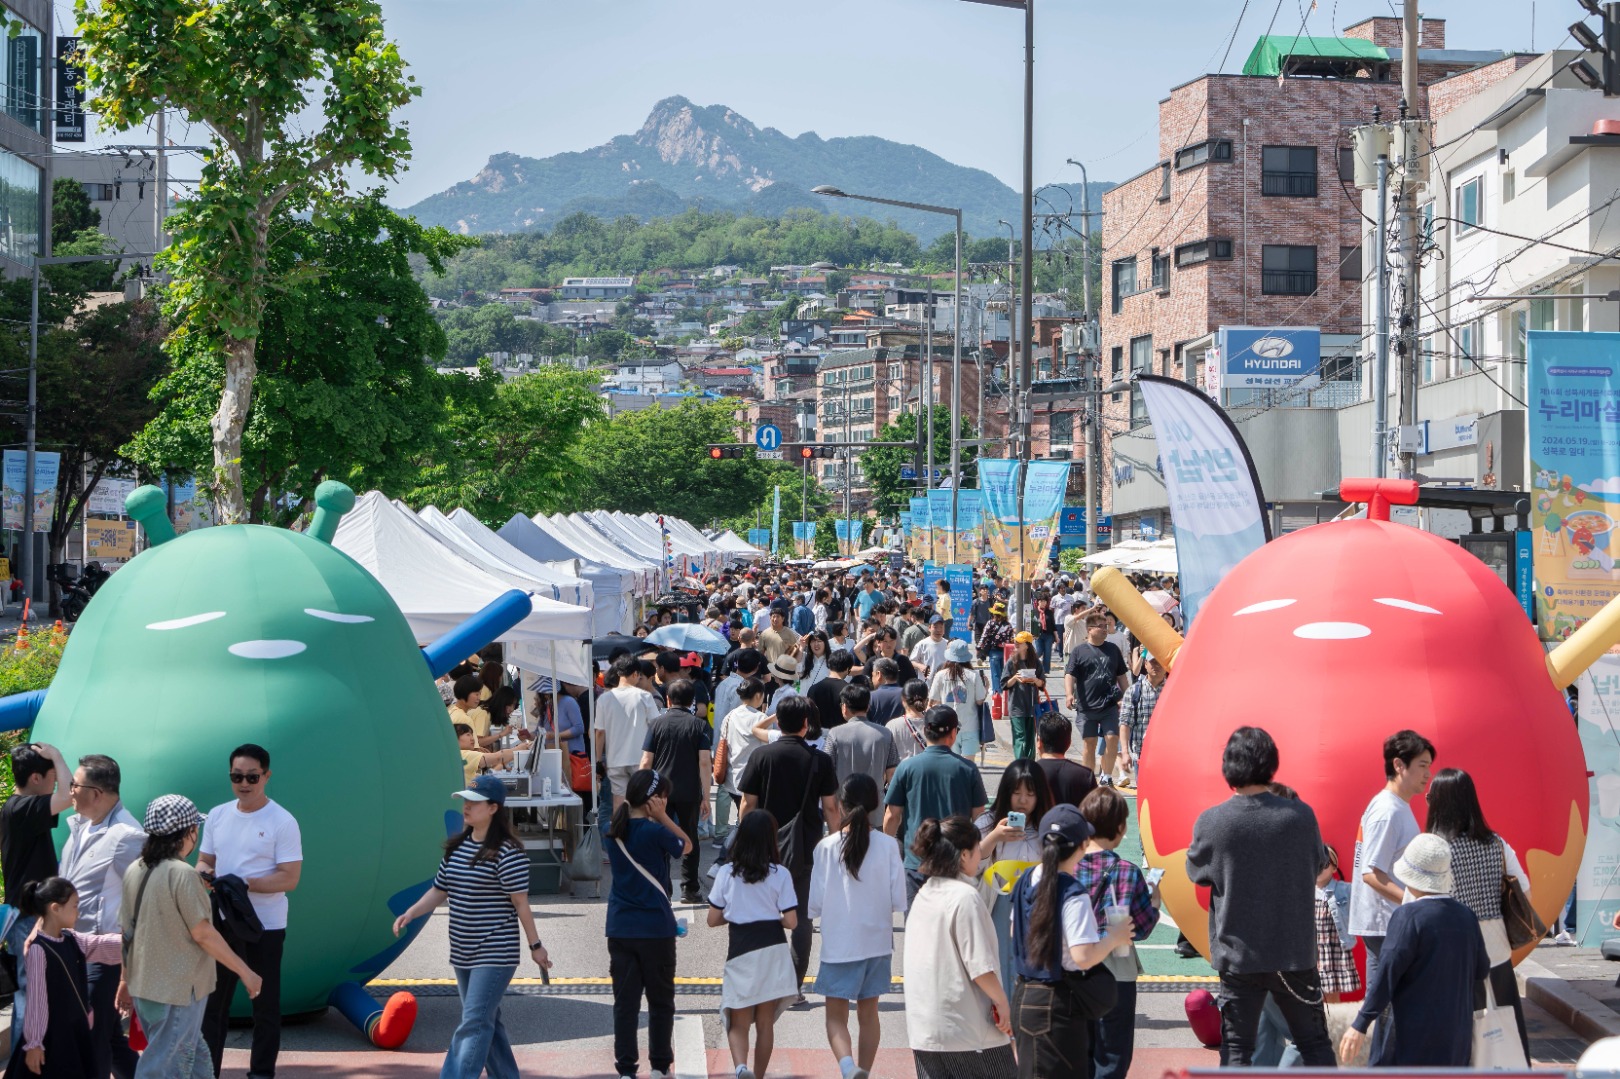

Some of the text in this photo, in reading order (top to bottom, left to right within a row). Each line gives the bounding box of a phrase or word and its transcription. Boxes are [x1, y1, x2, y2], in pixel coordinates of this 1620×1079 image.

[64, 40, 77, 80] 성동
[1244, 359, 1302, 369] HYUNDAI
[1539, 399, 1620, 423] 누리마실
[1542, 446, 1567, 456] 성북로
[1569, 447, 1585, 457] 일대
